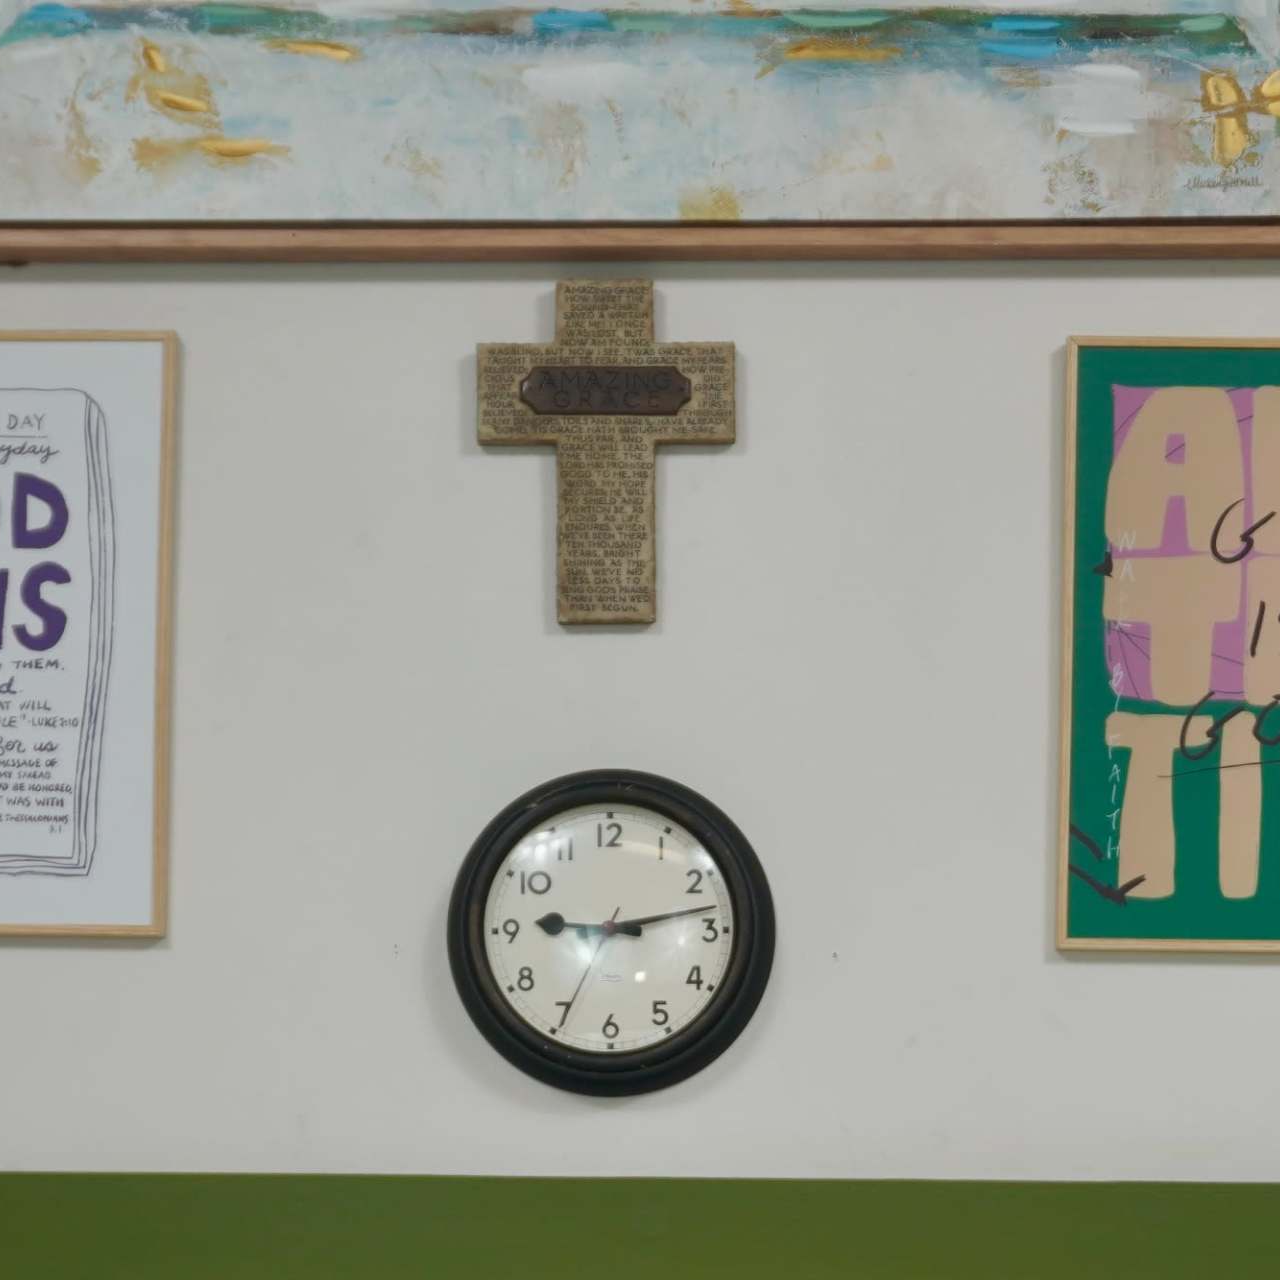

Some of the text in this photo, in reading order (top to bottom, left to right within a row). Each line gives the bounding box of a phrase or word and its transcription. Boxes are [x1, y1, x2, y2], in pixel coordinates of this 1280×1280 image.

[540, 369, 672, 392] AMAZING
[553, 390, 661, 409] GRACE
[7, 413, 48, 431] DAY
[19, 699, 52, 711] WILL
[32, 740, 60, 753] us
[11, 782, 26, 792] BE
[6, 796, 32, 808] WAS
[34, 797, 66, 808] WITH
[596, 821, 624, 849] 12
[657, 835, 665, 861] 1
[557, 837, 574, 862] 11
[519, 870, 552, 895] 10
[685, 868, 704, 895] 2
[501, 917, 521, 944] 9
[701, 916, 719, 943] 3
[516, 965, 535, 992] 8
[685, 964, 704, 992] 4
[554, 1000, 572, 1029] 7
[601, 1012, 620, 1039] 6
[651, 1000, 670, 1026] 5
